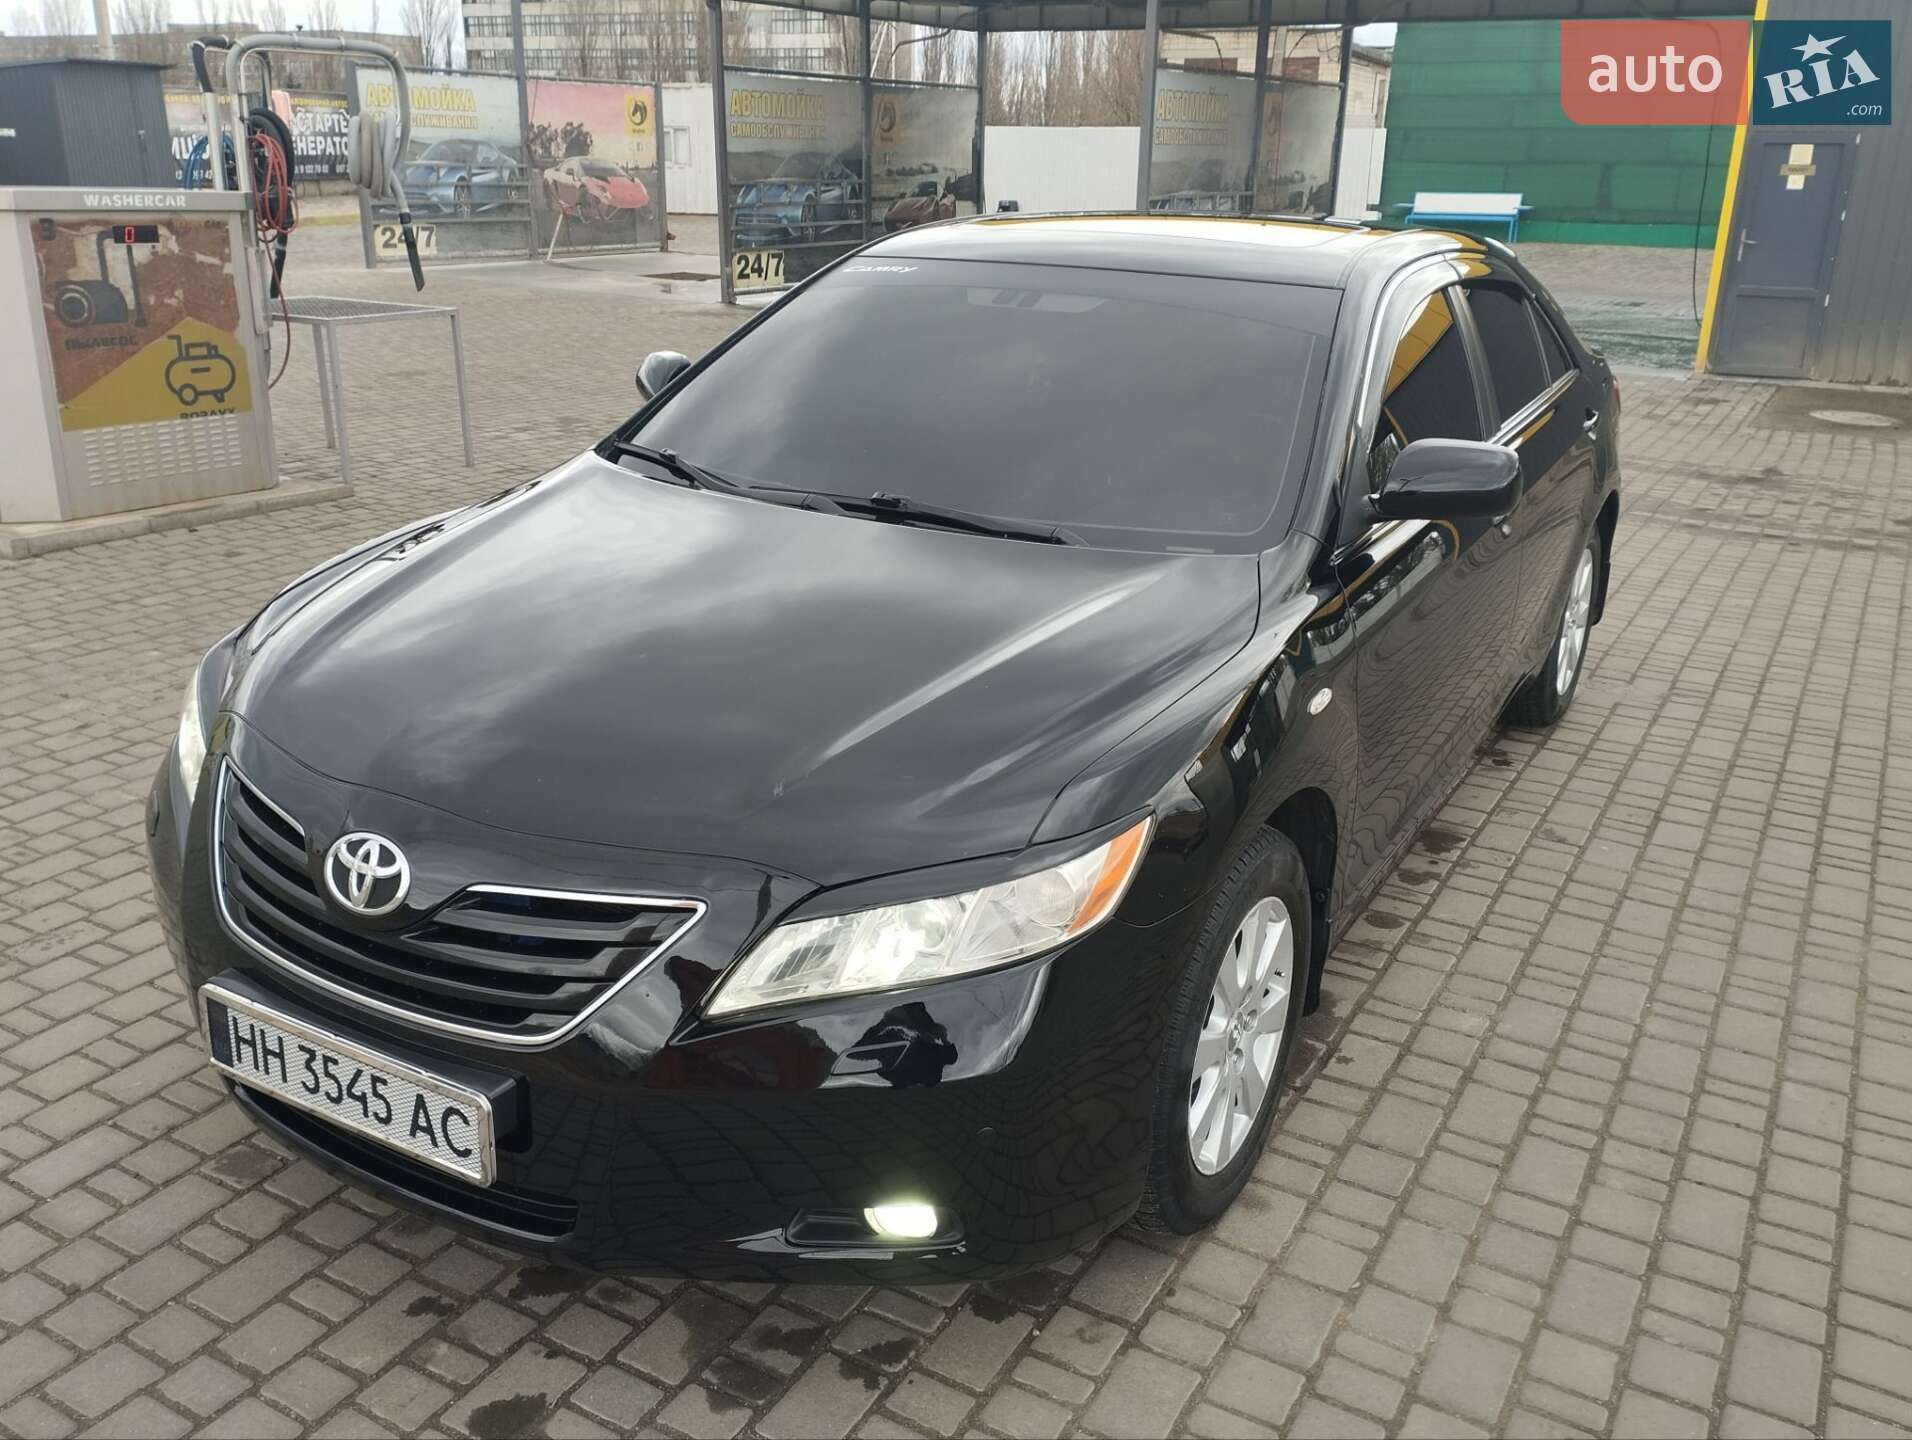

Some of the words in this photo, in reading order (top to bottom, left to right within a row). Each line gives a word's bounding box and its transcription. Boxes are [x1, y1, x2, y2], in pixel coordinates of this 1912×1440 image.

[367, 83, 476, 112] АВМОЙКА
[730, 88, 825, 120] АВТОМОЙКА
[292, 135, 349, 156] ЕНЕРАТО
[83, 193, 187, 208] WASHERCAR
[125, 226, 135, 243] 0
[737, 253, 784, 281] 24/7
[298, 1043, 393, 1126] 3545
[409, 1093, 473, 1158] AC
